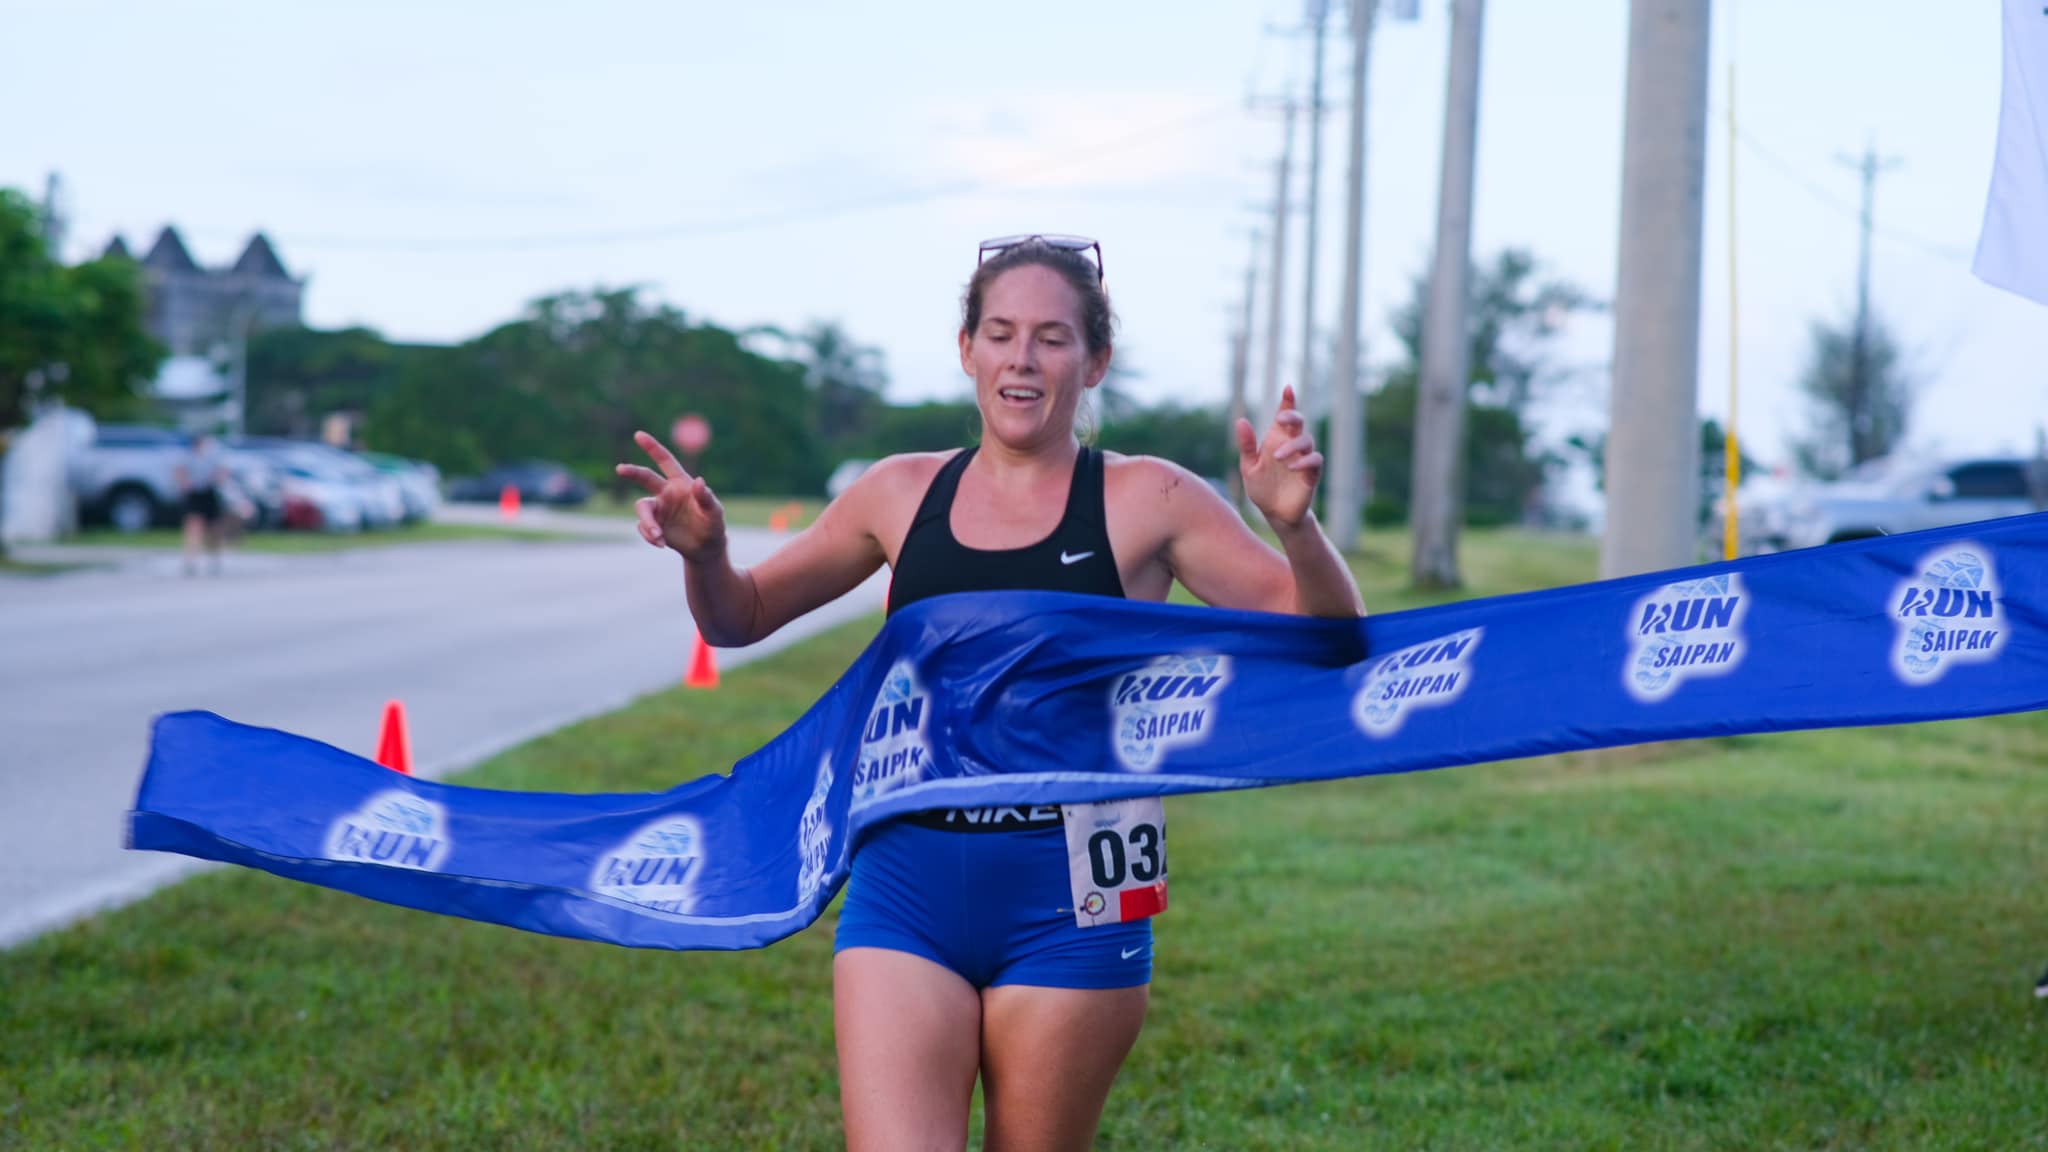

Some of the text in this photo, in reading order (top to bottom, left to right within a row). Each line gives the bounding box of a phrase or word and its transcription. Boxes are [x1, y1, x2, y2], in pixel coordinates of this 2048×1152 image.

[1638, 596, 1739, 635] RUN
[1900, 587, 1994, 618] RUN
[1377, 637, 1472, 675] RUN
[1653, 642, 1735, 668] SAIPAN
[1921, 629, 1998, 653] SAIPAN
[1115, 674, 1223, 705] RUN
[1381, 671, 1461, 701] SAIPAN
[863, 697, 924, 743] UN
[1135, 709, 1205, 742] SAIPAN
[945, 806, 1058, 823] NIKE
[338, 822, 440, 867] RUN
[1088, 823, 1168, 888] 03
[602, 856, 697, 886] RUN
